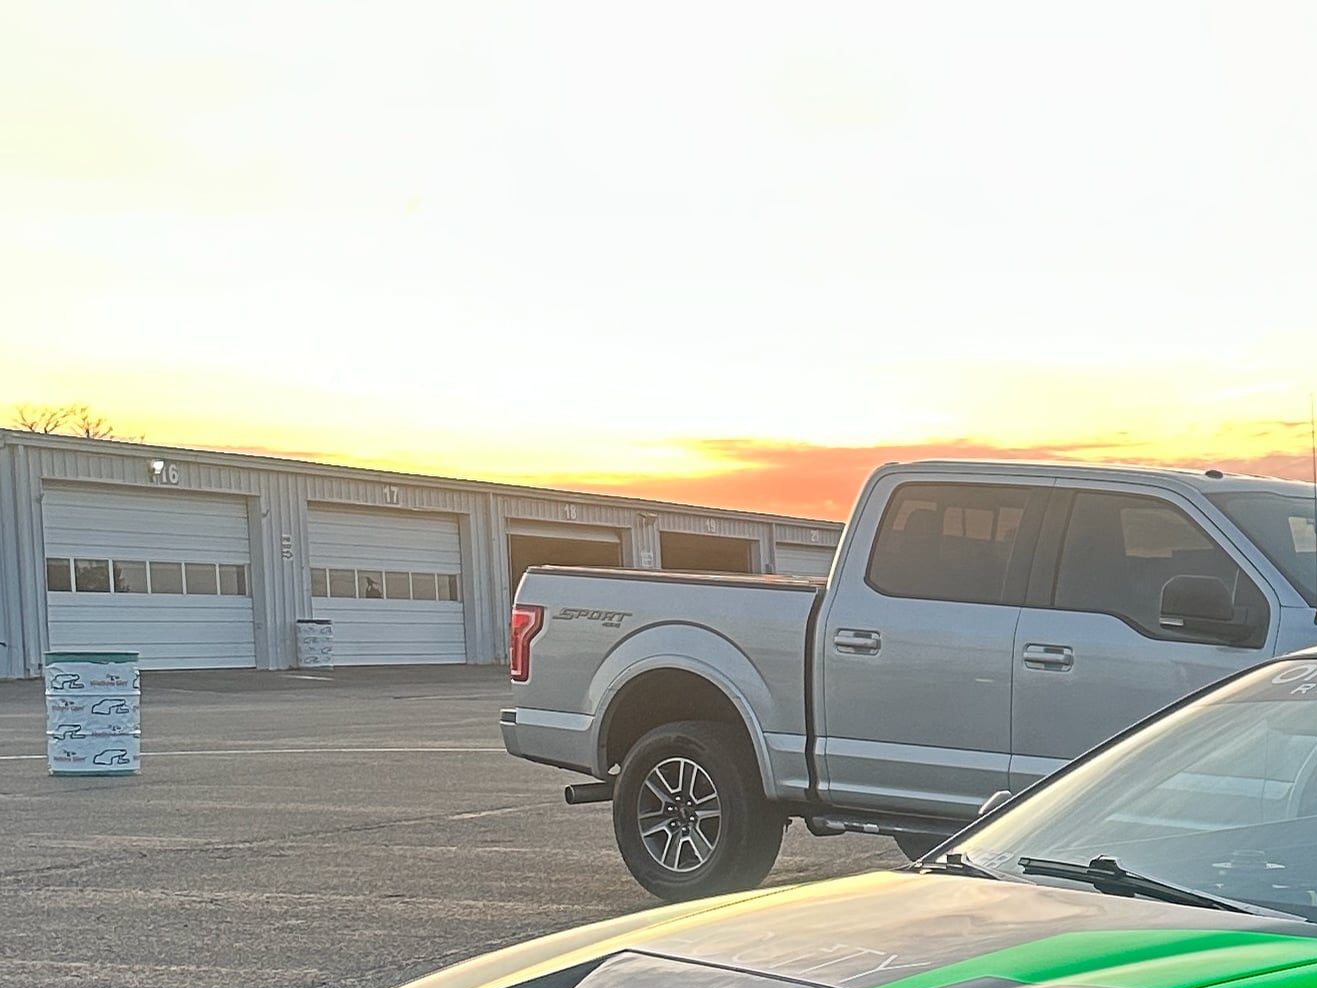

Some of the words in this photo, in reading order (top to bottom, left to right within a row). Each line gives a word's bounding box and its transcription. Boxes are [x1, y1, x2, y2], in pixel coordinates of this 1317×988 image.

[162, 463, 179, 484] 16
[384, 486, 400, 503] 17
[564, 504, 577, 520] 18
[705, 519, 717, 532] 19
[552, 608, 632, 622] SPORT
